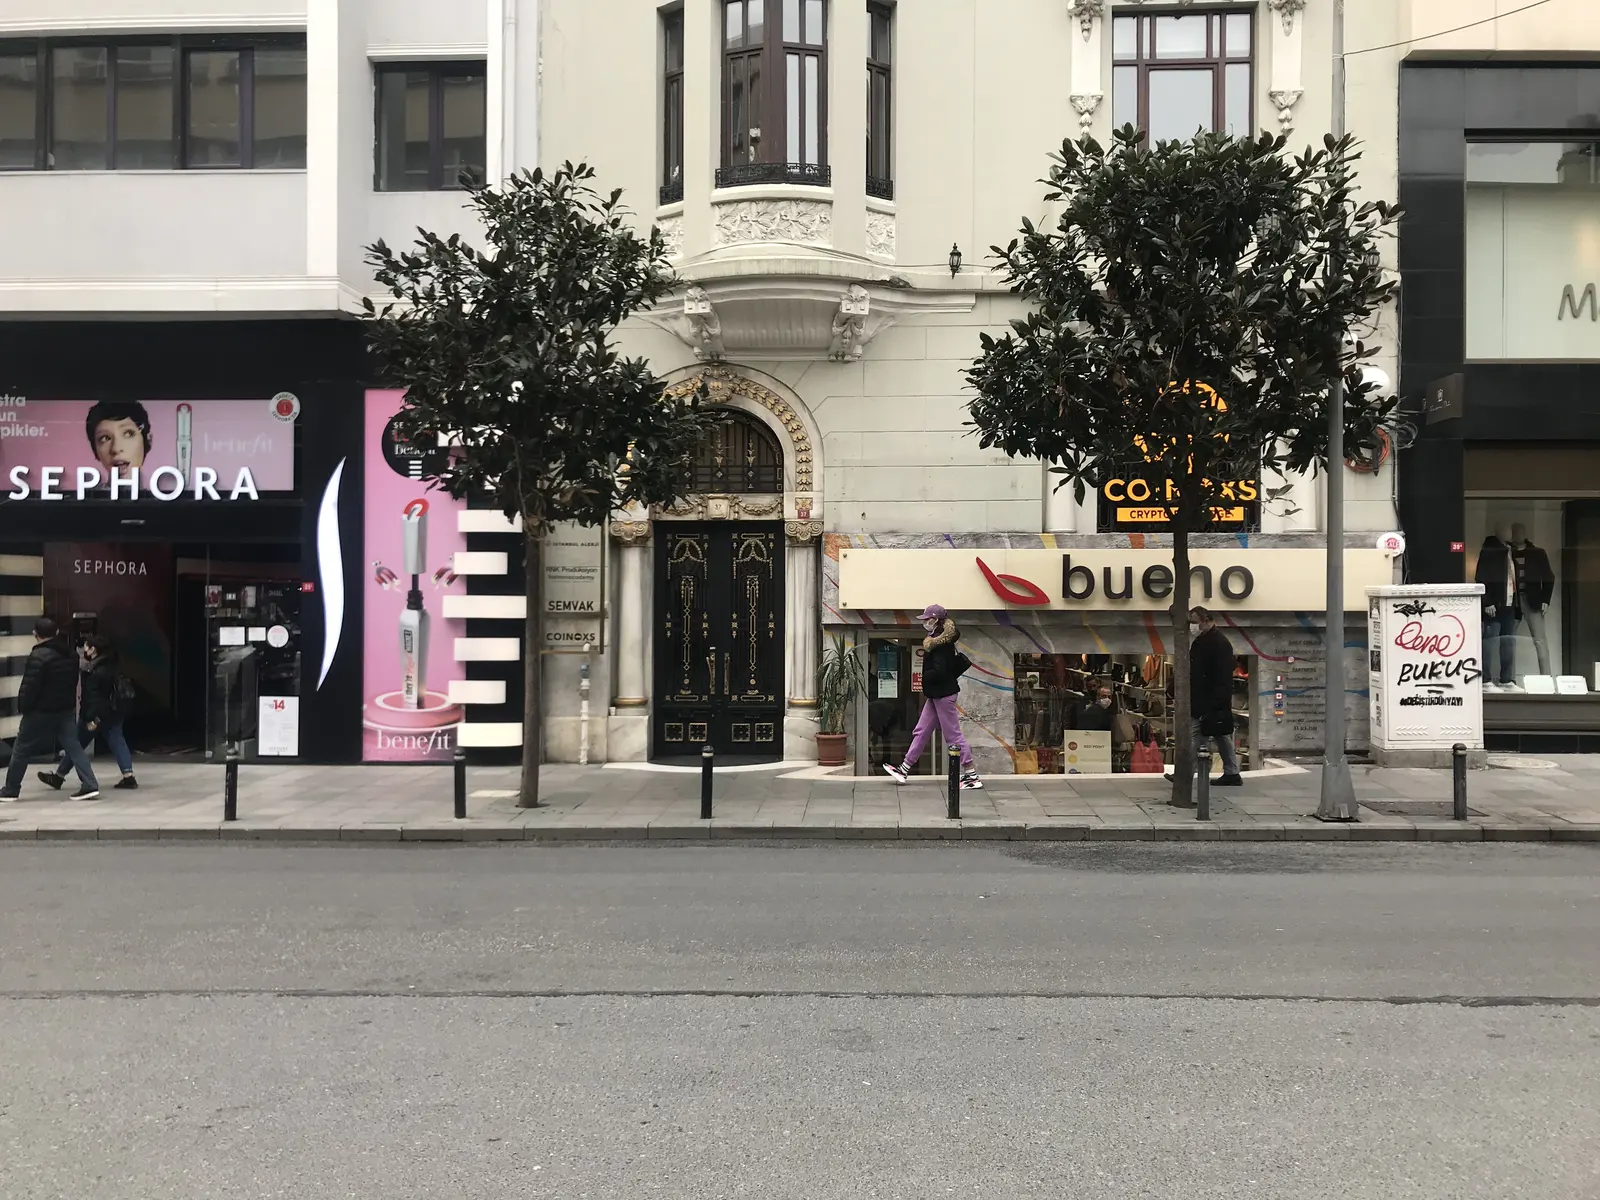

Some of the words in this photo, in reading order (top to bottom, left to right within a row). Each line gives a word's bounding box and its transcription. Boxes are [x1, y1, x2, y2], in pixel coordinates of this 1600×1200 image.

[1557, 282, 1600, 322] M
[8, 465, 260, 501] SEPHORA
[74, 560, 147, 576] SEPHORA
[1061, 554, 1254, 601] bueno
[548, 600, 594, 611] SEMVAK
[546, 632, 596, 641] COINOXS
[273, 699, 285, 710] 14
[376, 729, 452, 755] benefit
